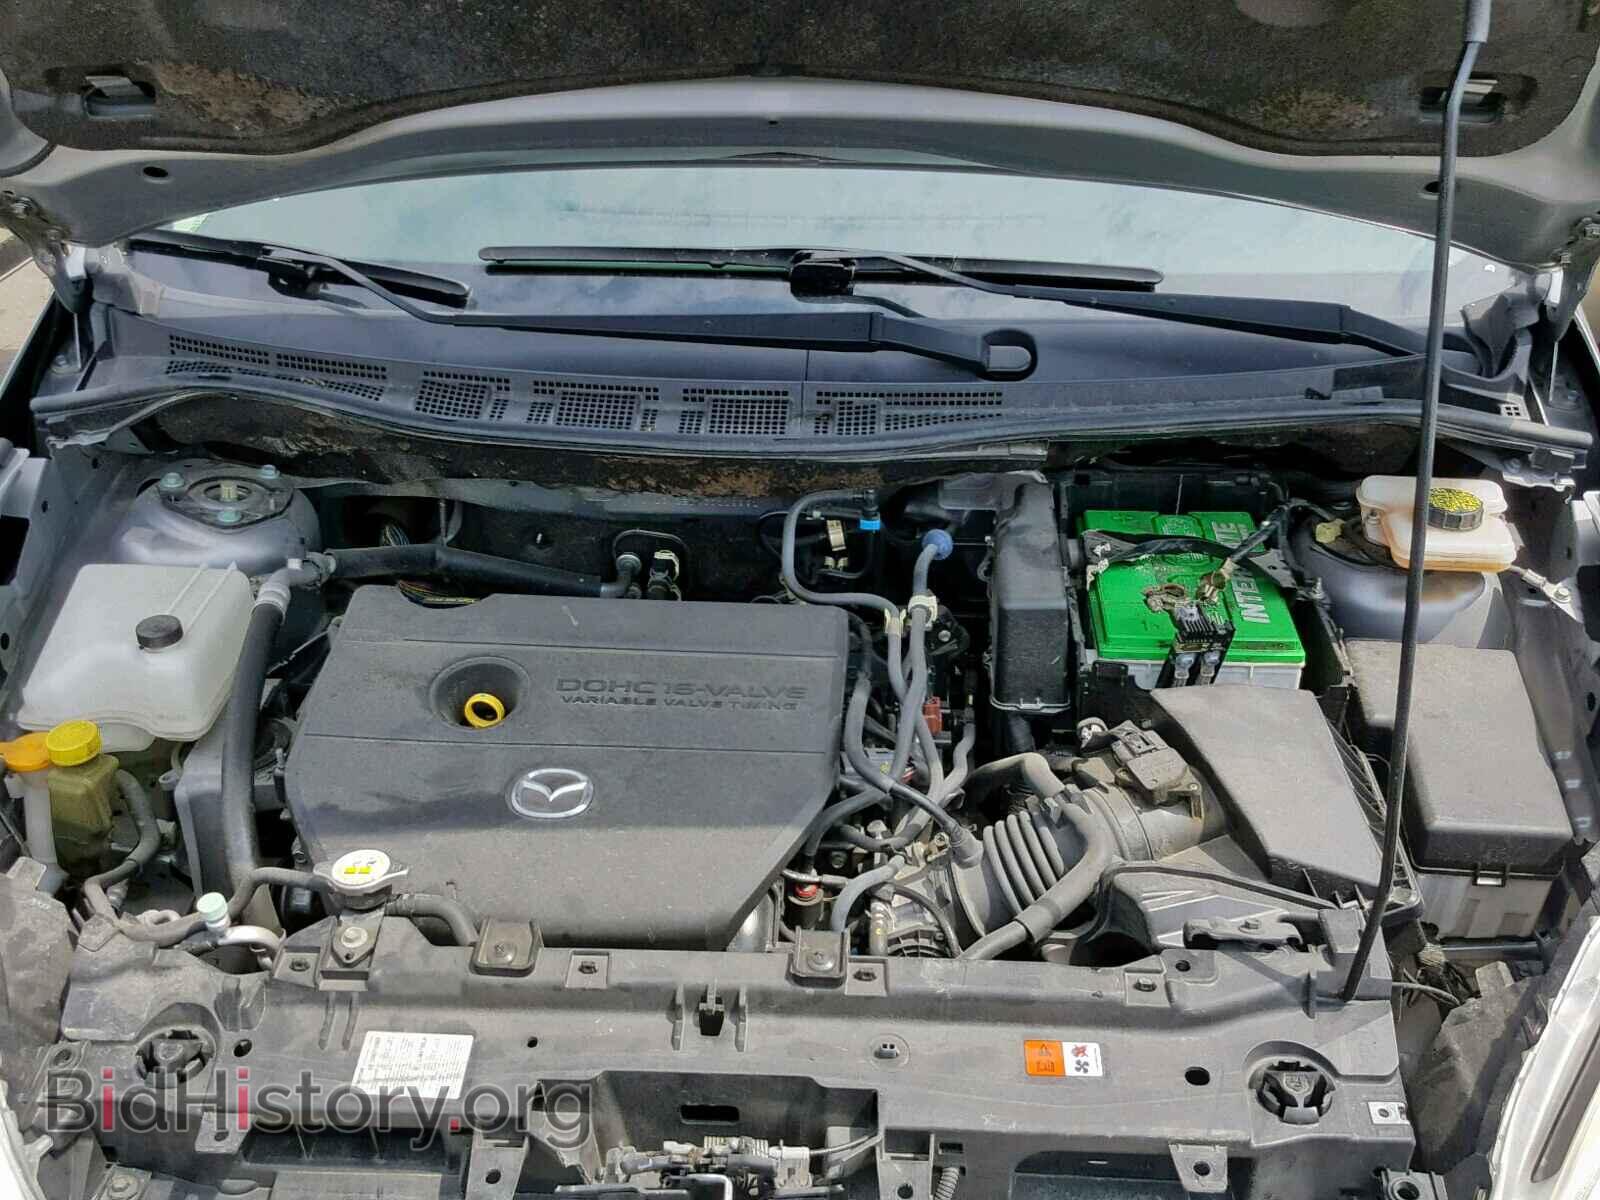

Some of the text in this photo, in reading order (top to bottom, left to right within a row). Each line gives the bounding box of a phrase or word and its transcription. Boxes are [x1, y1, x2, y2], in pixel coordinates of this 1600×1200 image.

[556, 678, 808, 699] DOHC 16-VALVE
[560, 694, 657, 706] VARIABLE
[664, 697, 723, 709] VALVE
